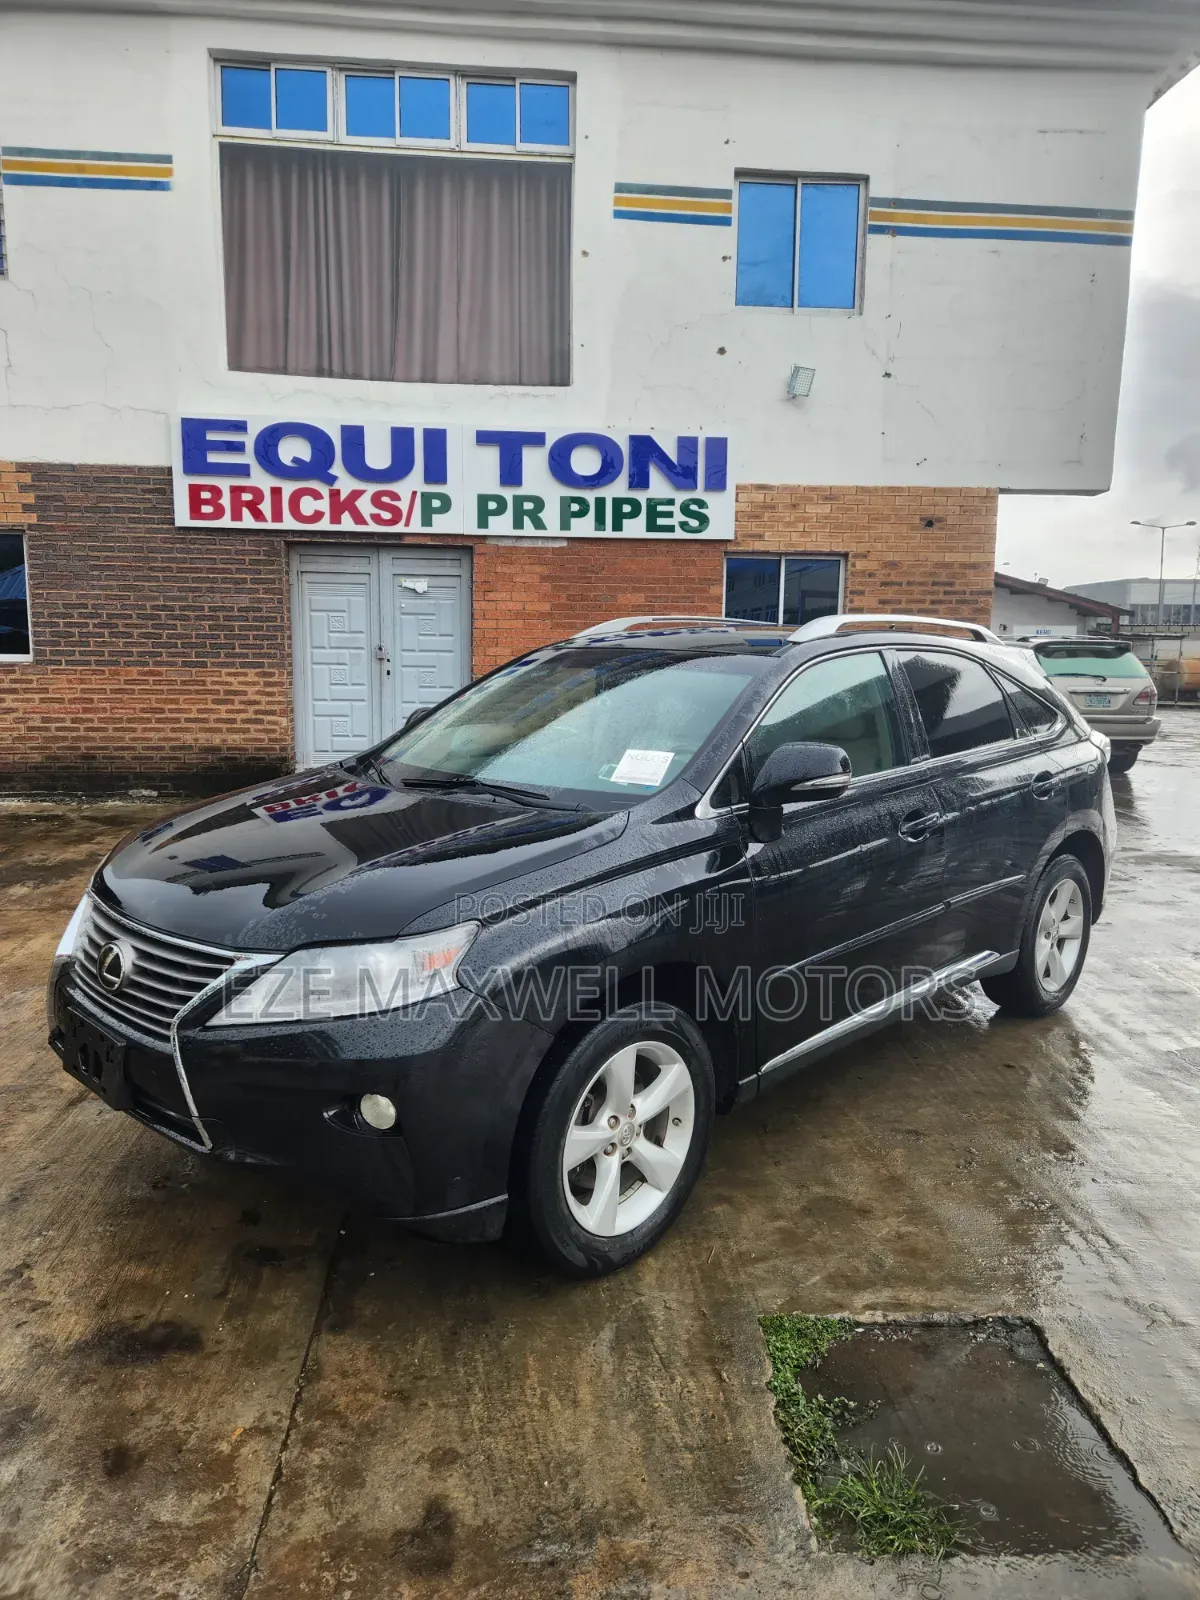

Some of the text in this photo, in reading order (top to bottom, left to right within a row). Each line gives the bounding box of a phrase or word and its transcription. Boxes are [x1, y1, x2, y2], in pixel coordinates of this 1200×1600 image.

[181, 417, 728, 492] EQUI TONI
[188, 483, 710, 534] BRICKS/P PR PIPES
